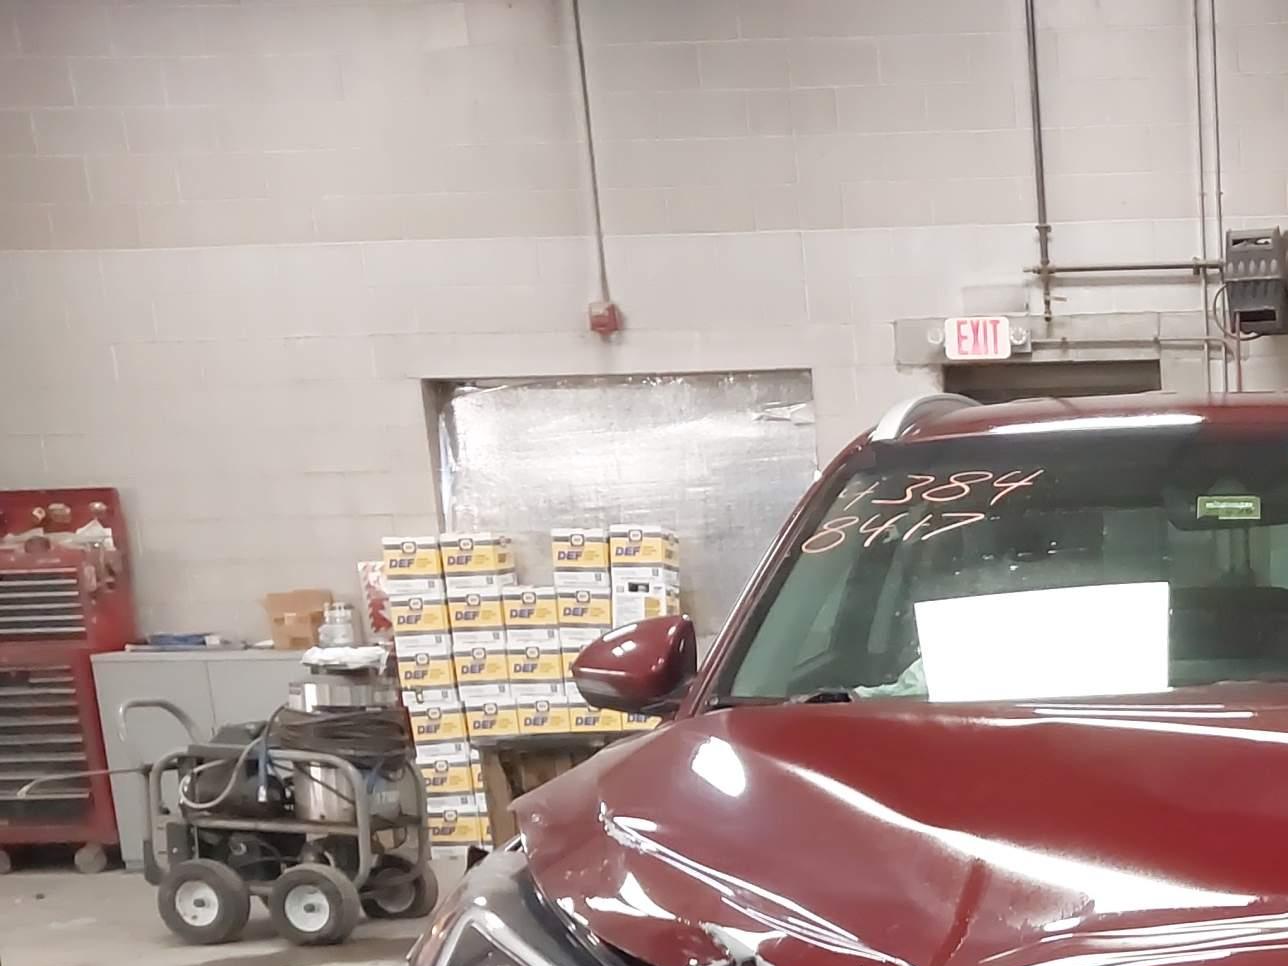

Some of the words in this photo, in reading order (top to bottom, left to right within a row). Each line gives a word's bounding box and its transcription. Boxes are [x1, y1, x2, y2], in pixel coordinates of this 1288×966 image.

[957, 319, 1000, 355] EXIT
[801, 512, 985, 554] 8417
[557, 551, 583, 561] DEF
[615, 546, 640, 556] DEF
[389, 558, 415, 568] DEF
[447, 555, 472, 565] DEF
[455, 611, 480, 621] DEF
[510, 608, 535, 618] DEF
[563, 607, 588, 616] DEF
[397, 614, 422, 625] DEF
[461, 664, 485, 674] DEF
[513, 663, 538, 673] DEF
[404, 670, 428, 680] DEF
[473, 720, 497, 730] DEF
[524, 716, 547, 727] DEF
[575, 716, 600, 726] DEF
[417, 724, 441, 735] DEF
